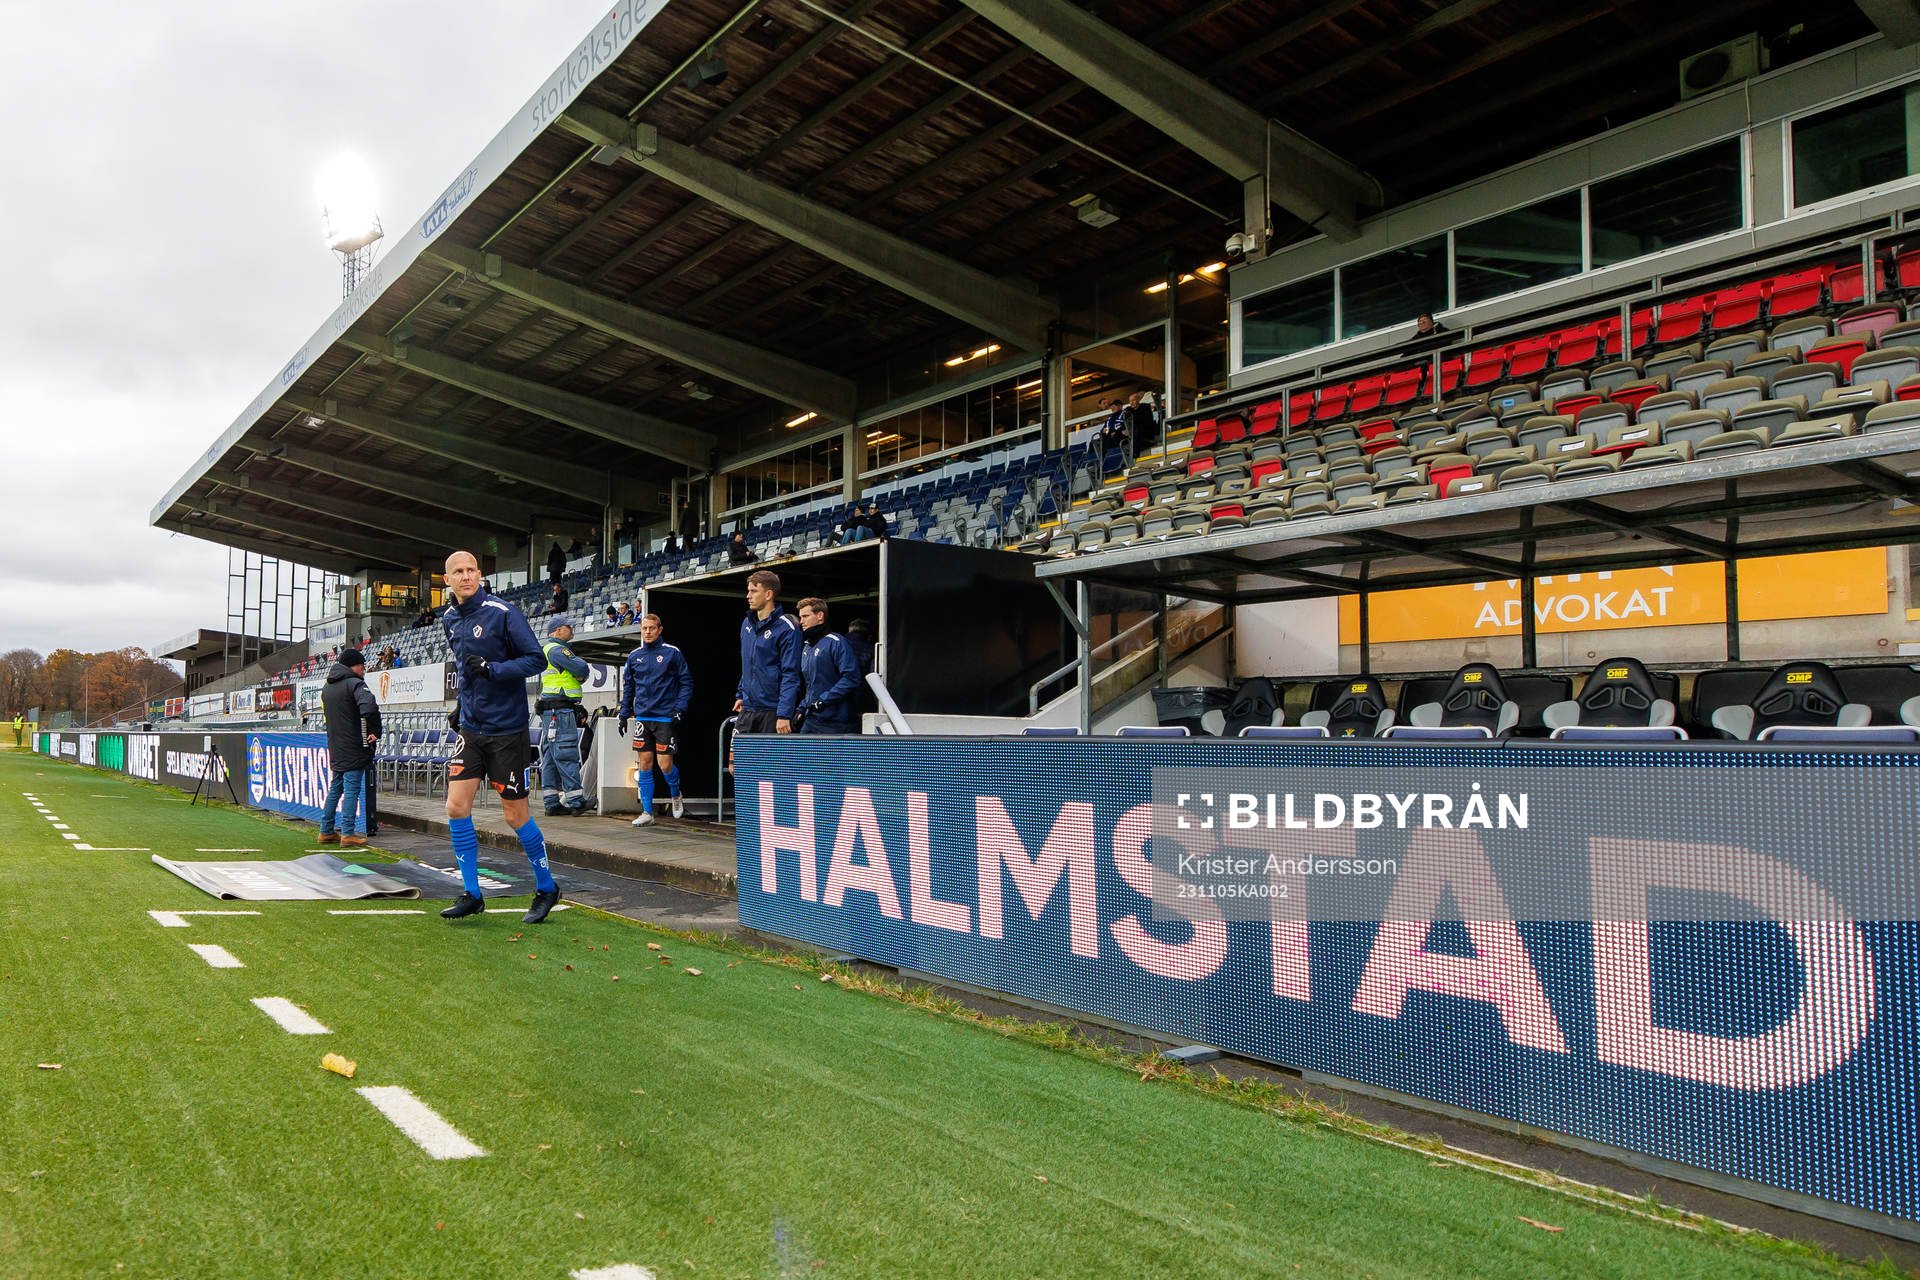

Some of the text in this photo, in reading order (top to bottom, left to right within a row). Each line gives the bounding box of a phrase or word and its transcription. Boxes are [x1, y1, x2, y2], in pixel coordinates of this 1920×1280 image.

[1474, 587, 1674, 628] ADVOKAT
[1463, 673, 1482, 682] OMP
[1606, 669, 1629, 678] OMP
[1786, 672, 1812, 682] OMP
[128, 734, 160, 781] UNIBET
[509, 771, 516, 783] 4
[757, 780, 1875, 1093] HALMSTAD
